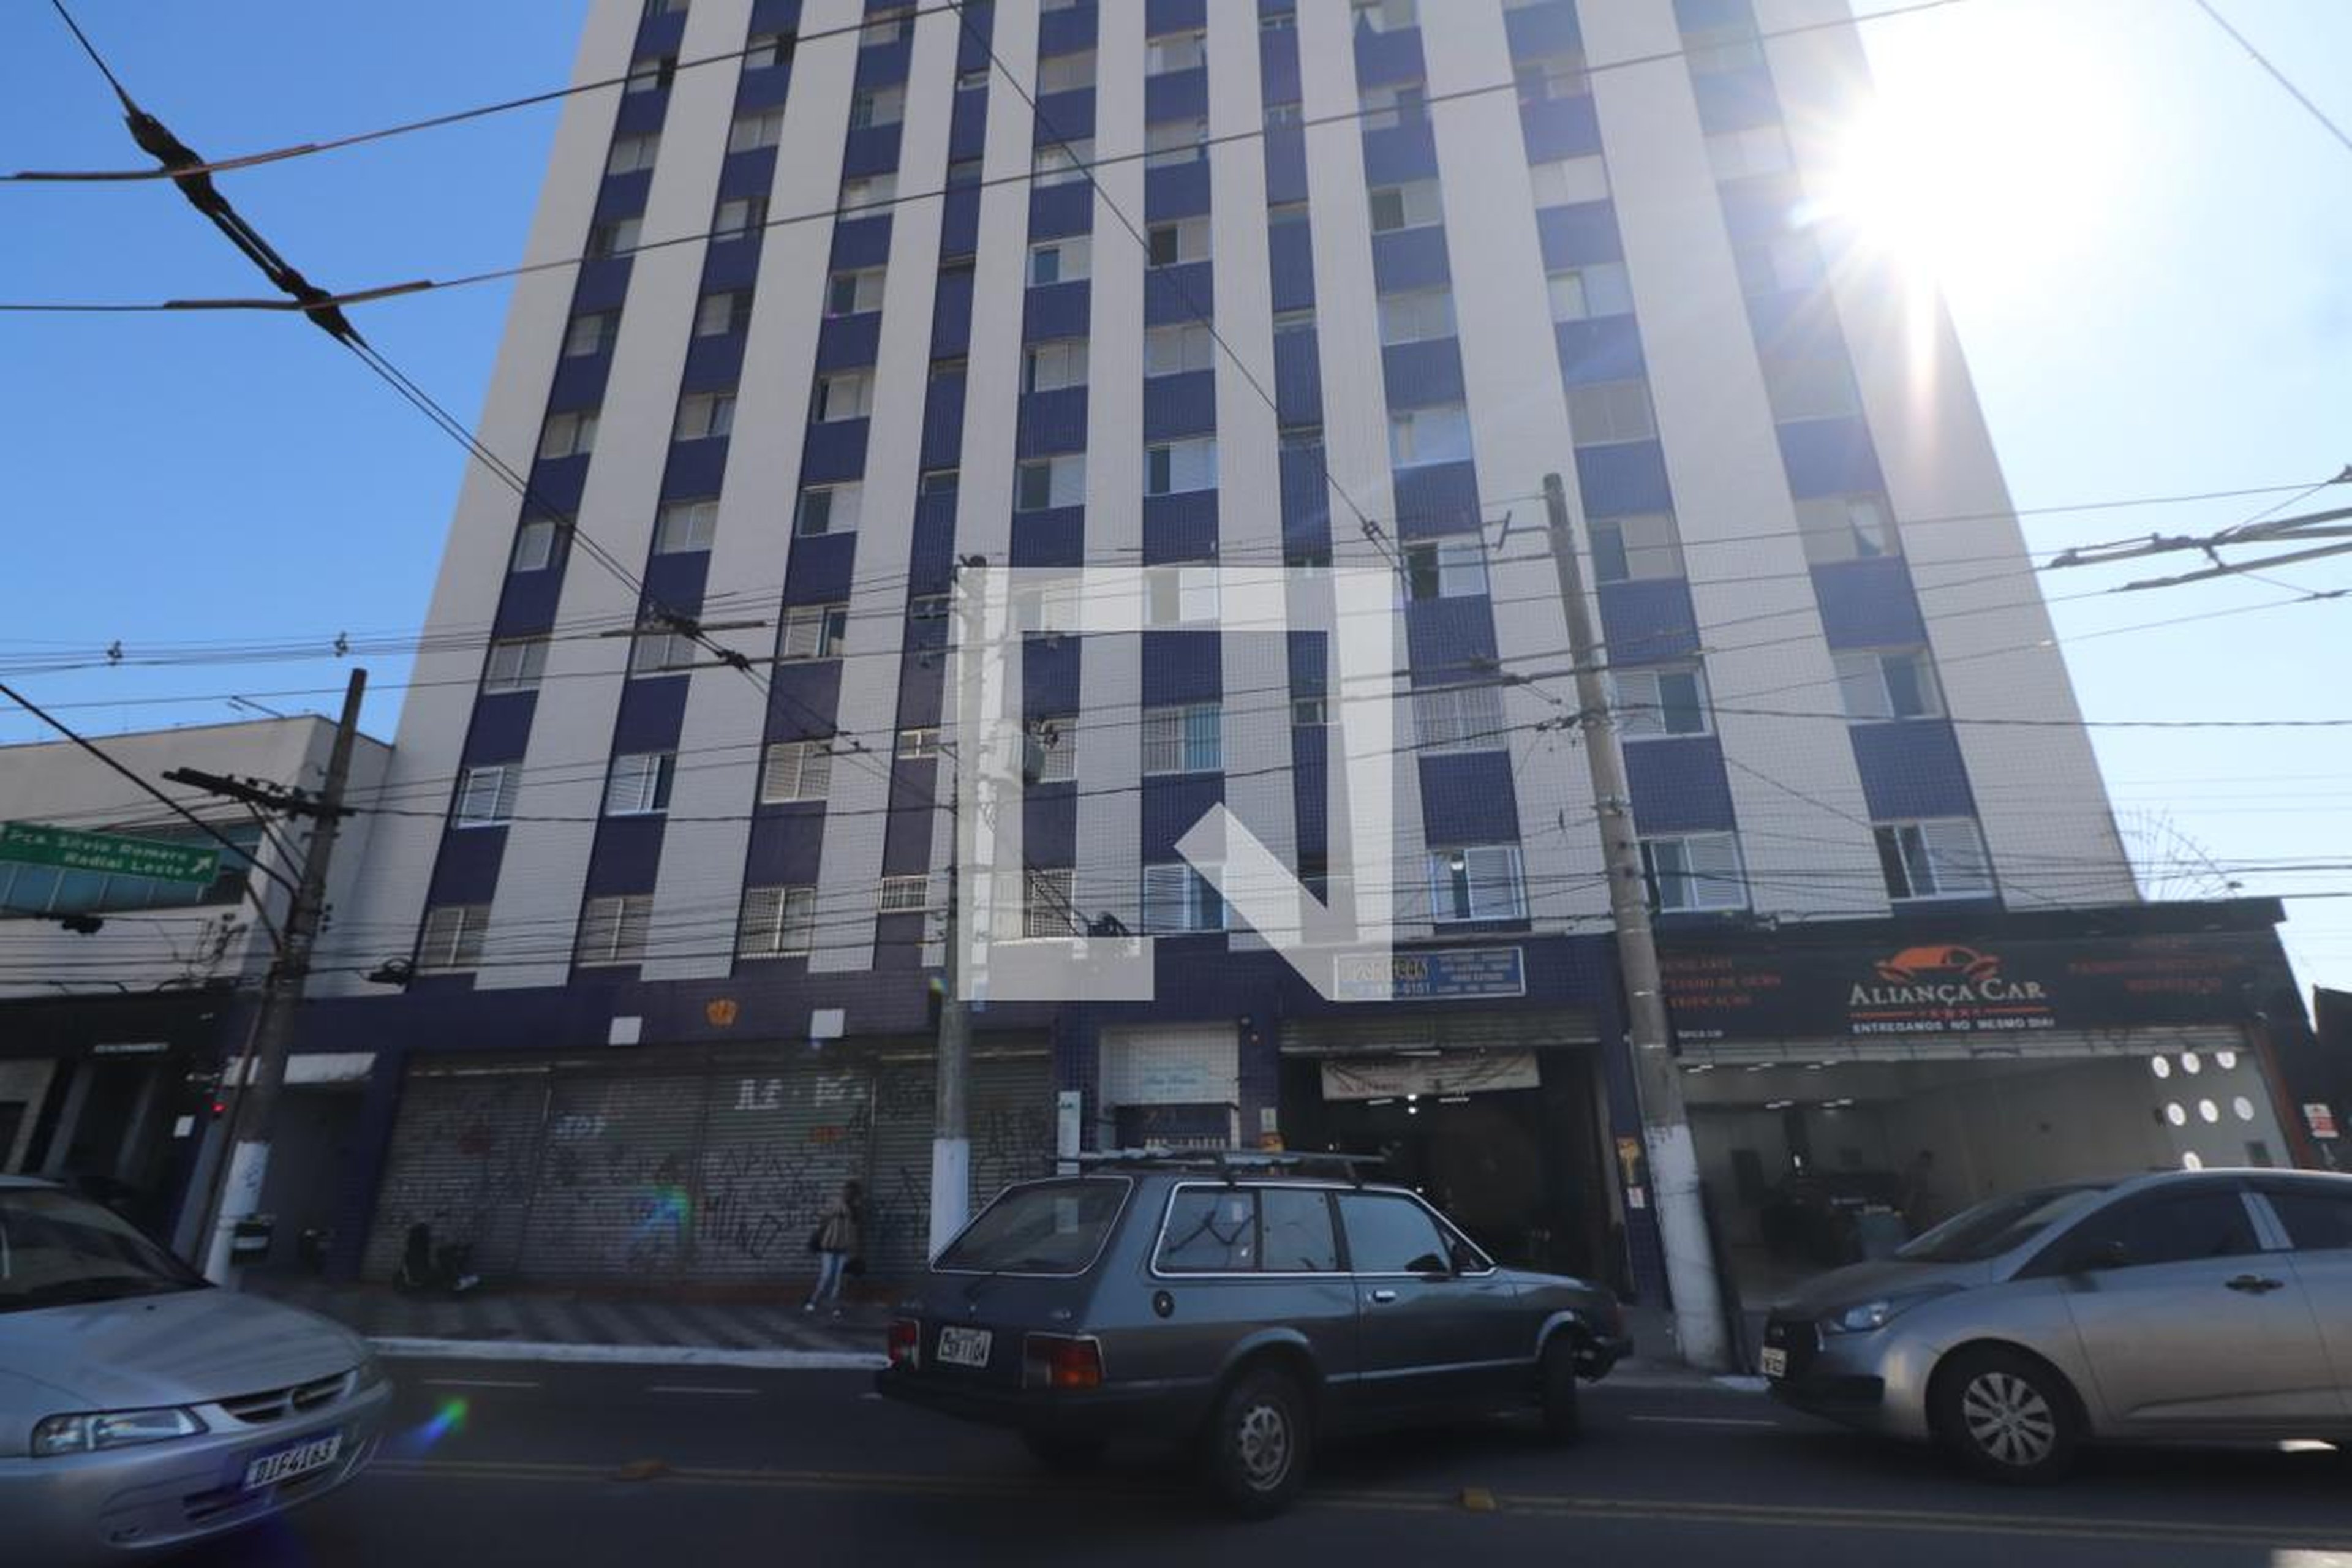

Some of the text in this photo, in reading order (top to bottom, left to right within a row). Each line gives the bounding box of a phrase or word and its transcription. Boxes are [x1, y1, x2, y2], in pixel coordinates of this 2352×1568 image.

[118, 843, 189, 862] Romero
[64, 852, 184, 876] Radial Leste
[1848, 978, 2046, 1006] ALIANÇA CAR
[1852, 1021, 1943, 1033] ENTREGAMOS
[1951, 1020, 1970, 1031] NO
[1977, 1019, 2026, 1031] MESMO
